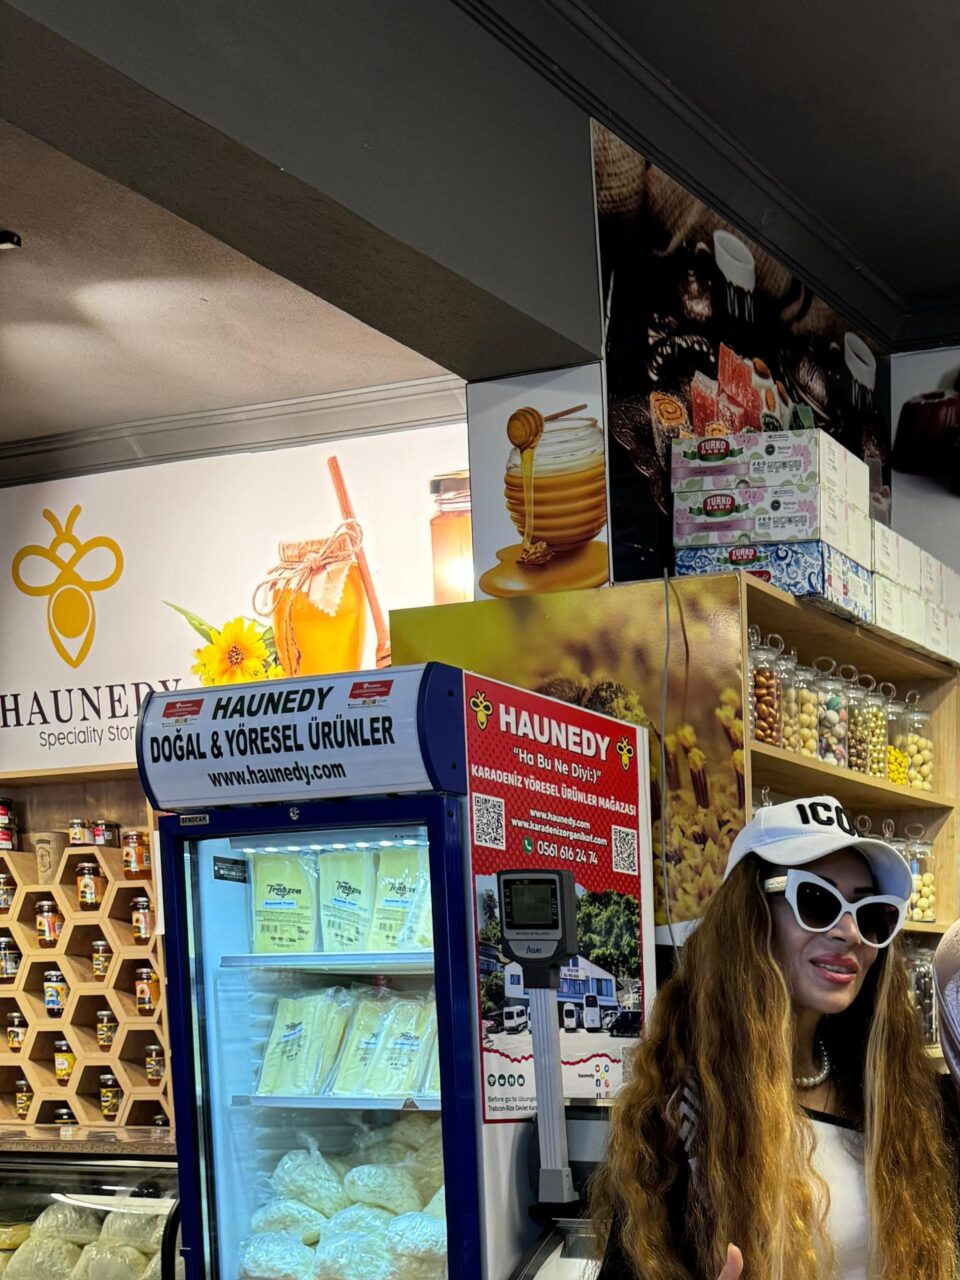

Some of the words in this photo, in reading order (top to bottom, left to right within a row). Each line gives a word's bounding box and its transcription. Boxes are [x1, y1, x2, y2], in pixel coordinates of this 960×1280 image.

[701, 440, 726, 450] TURKO
[706, 496, 732, 506] TURKO
[731, 548, 754, 556] TURKO
[212, 686, 335, 720] HAUNEDY
[39, 725, 104, 750] Speciality
[150, 728, 207, 763] DOĞAL
[210, 731, 224, 759] &
[227, 723, 304, 756] YÖRESEL
[308, 714, 395, 751] ÜRÜNLER
[499, 703, 610, 760] HAUNEDY
[207, 760, 346, 788] www.haunedy.com
[537, 753, 551, 770] Bu
[554, 759, 569, 775] Ne
[471, 764, 522, 788] KARADENİZ
[524, 776, 560, 797] YÖRESEL
[561, 783, 602, 808] ÜRÜNLER
[599, 795, 636, 816] MAĞAZASI
[529, 808, 590, 829] www.haunedy.com
[796, 802, 865, 838] ICO
[537, 840, 558, 857] 0561
[560, 844, 573, 861] 616
[575, 847, 587, 863] 24
[588, 850, 598, 865] 74
[266, 884, 302, 898] Trabzon
